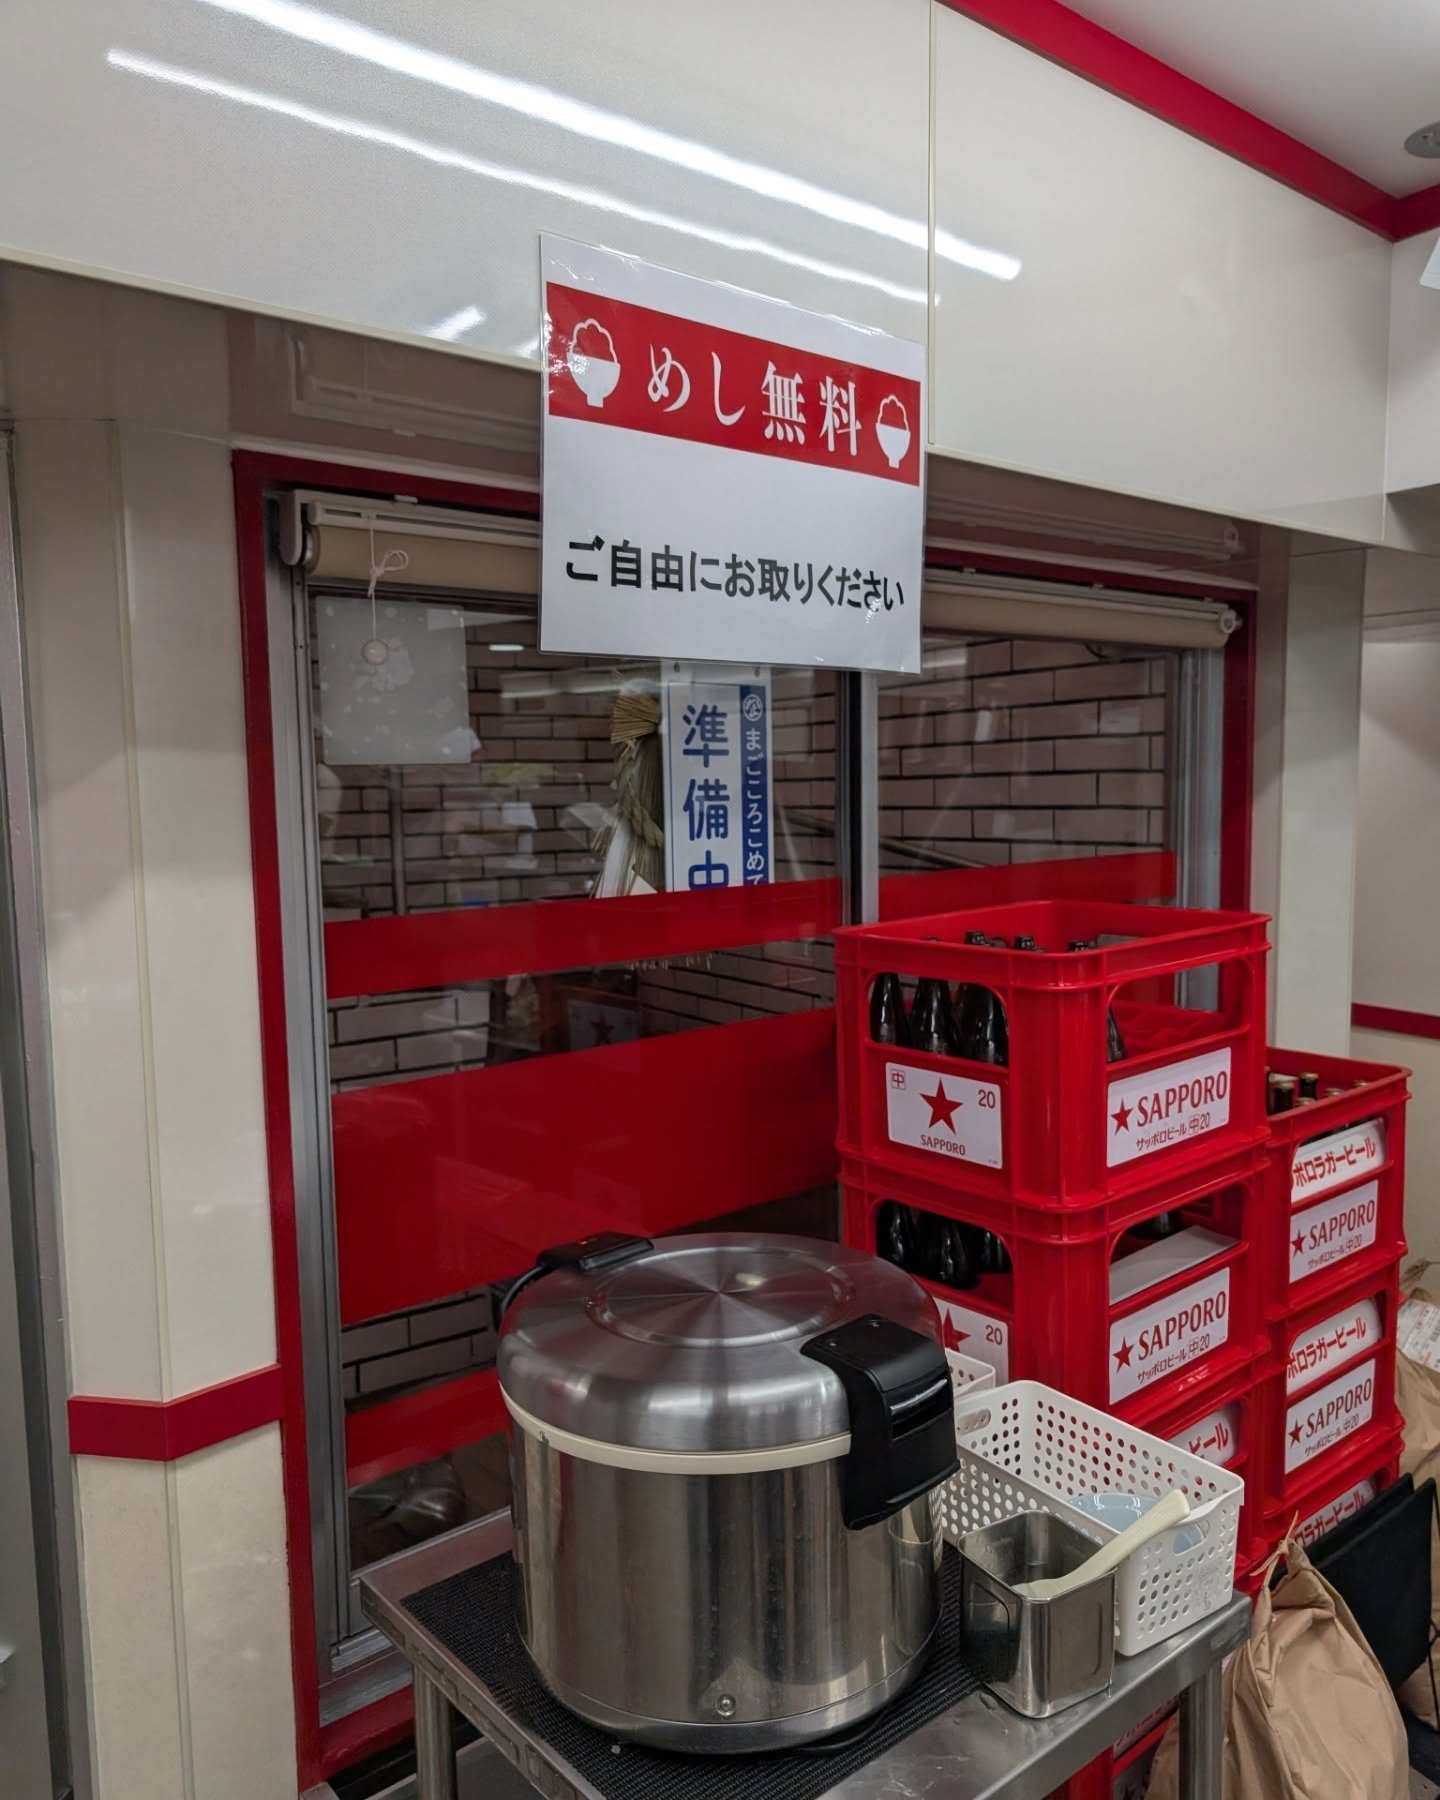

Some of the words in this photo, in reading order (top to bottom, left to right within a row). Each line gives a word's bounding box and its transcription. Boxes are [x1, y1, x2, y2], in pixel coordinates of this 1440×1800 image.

[647, 344, 862, 456] めし無料
[566, 535, 904, 611] ご自由にお取りください
[682, 704, 730, 890] 準備中
[978, 1089, 996, 1109] 20
[1136, 1071, 1227, 1127] SAPPORO
[920, 1134, 966, 1156] SAPPORO
[1136, 1123, 1187, 1151] サッポロビール
[1308, 1200, 1375, 1250] SAPPORO
[985, 1324, 1003, 1345] 20
[1138, 1290, 1226, 1361] SAPPORO
[1137, 1348, 1187, 1384] サッポロビール
[1306, 1378, 1372, 1438] SAPPORO
